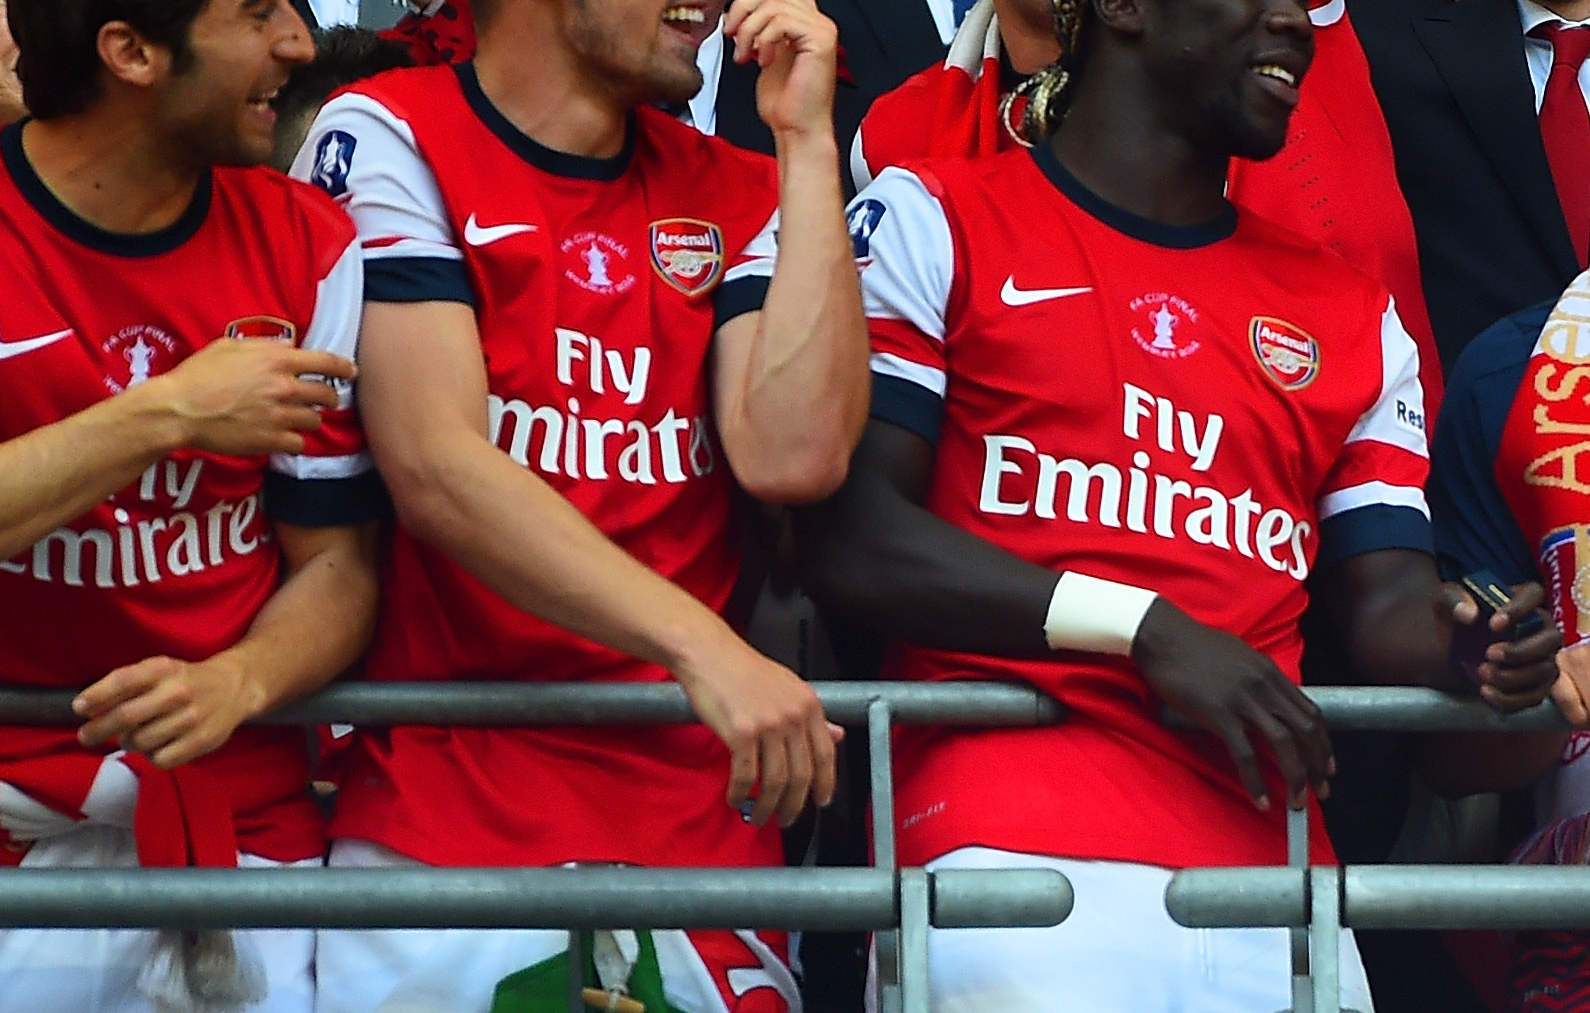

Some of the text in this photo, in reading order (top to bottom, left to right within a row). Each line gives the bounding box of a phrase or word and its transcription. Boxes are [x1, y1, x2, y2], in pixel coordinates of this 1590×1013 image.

[657, 231, 710, 246] Arsenal
[555, 327, 650, 404] Fly
[1260, 326, 1310, 354] Arsenal
[1123, 382, 1223, 471] Fly
[139, 459, 204, 509] ly
[980, 434, 1311, 580] Emirates
[0, 496, 271, 588] mirate
